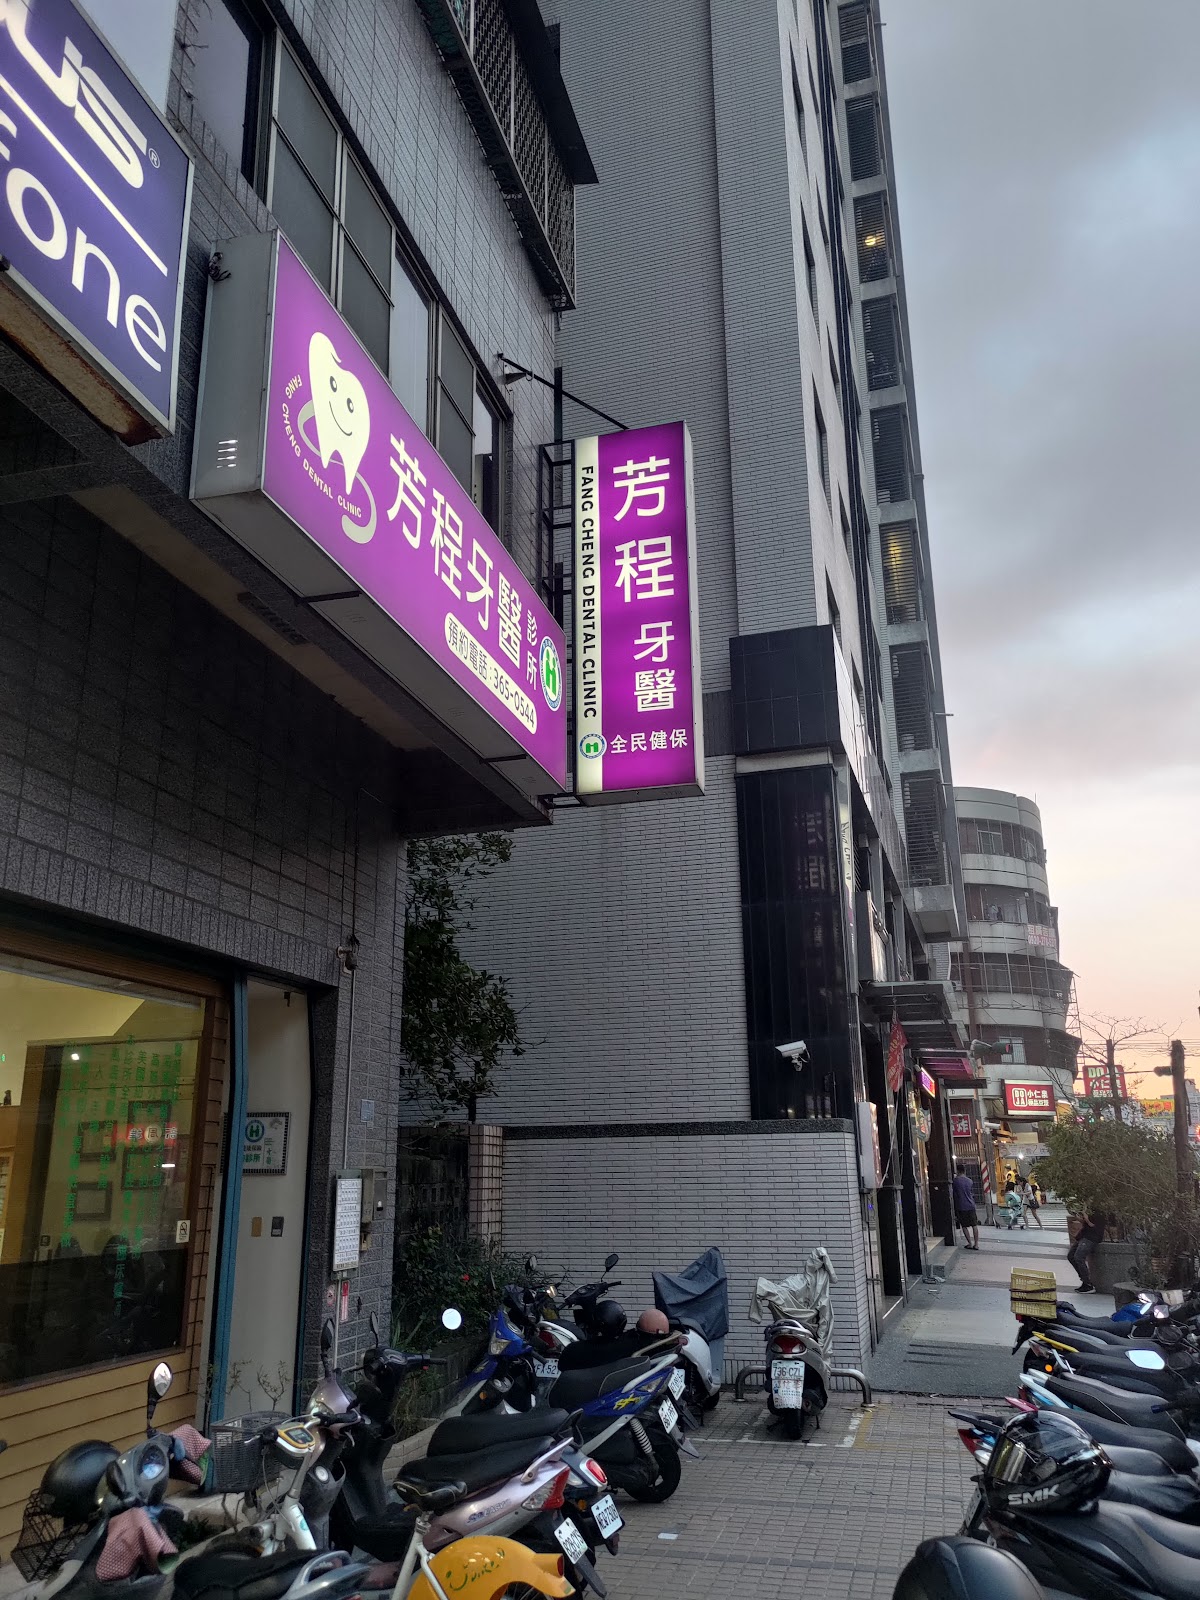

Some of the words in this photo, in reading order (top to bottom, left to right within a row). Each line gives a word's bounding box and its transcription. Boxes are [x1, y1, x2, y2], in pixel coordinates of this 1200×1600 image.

[285, 374, 303, 399] FANG
[282, 402, 302, 457] CHENG
[303, 458, 334, 499] DENTAL
[581, 466, 594, 512] FANG
[337, 494, 362, 518] CLINIC
[581, 518, 595, 579] CHENG
[582, 585, 597, 655] DENTAL
[582, 658, 597, 718] CLINIC
[610, 728, 688, 754] 全民健保
[1008, 1484, 1060, 1506] SMK
